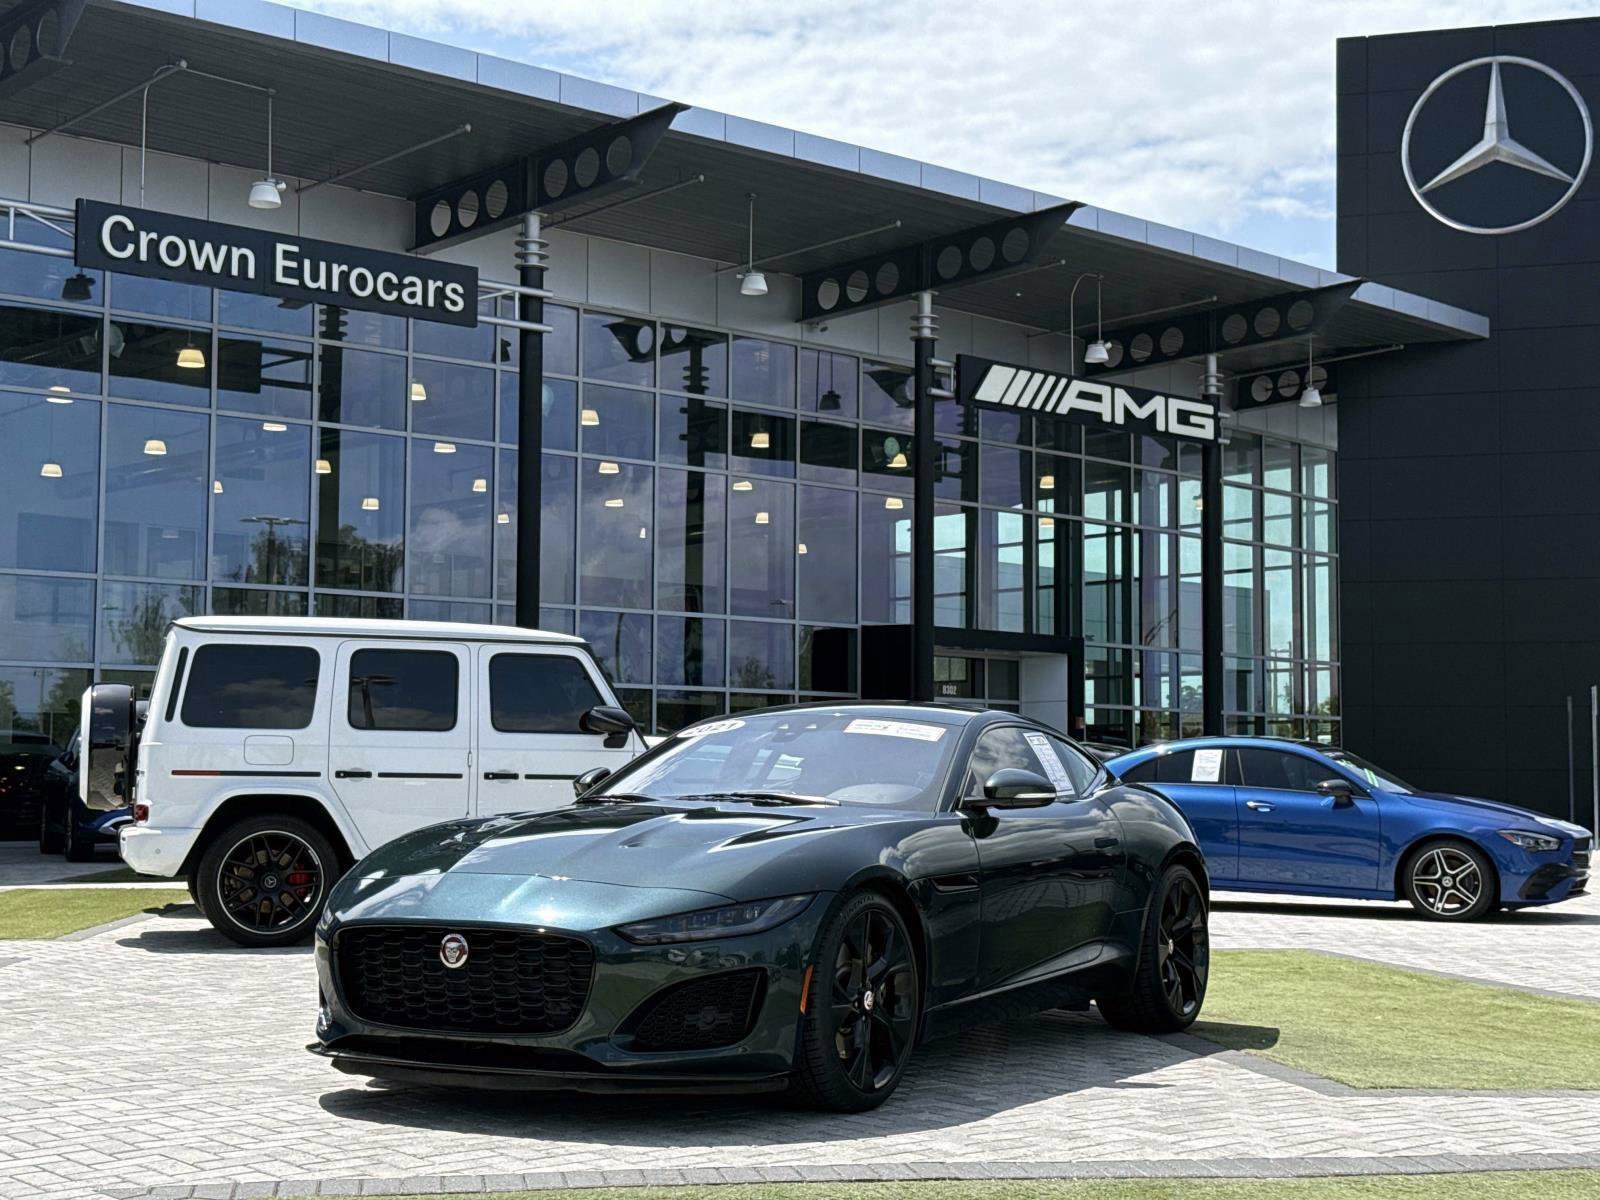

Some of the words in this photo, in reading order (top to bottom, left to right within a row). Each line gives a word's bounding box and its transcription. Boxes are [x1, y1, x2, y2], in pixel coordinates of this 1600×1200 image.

[101, 214, 256, 279] Crown
[275, 242, 465, 312] Eurocars
[1056, 379, 1214, 440] AMG
